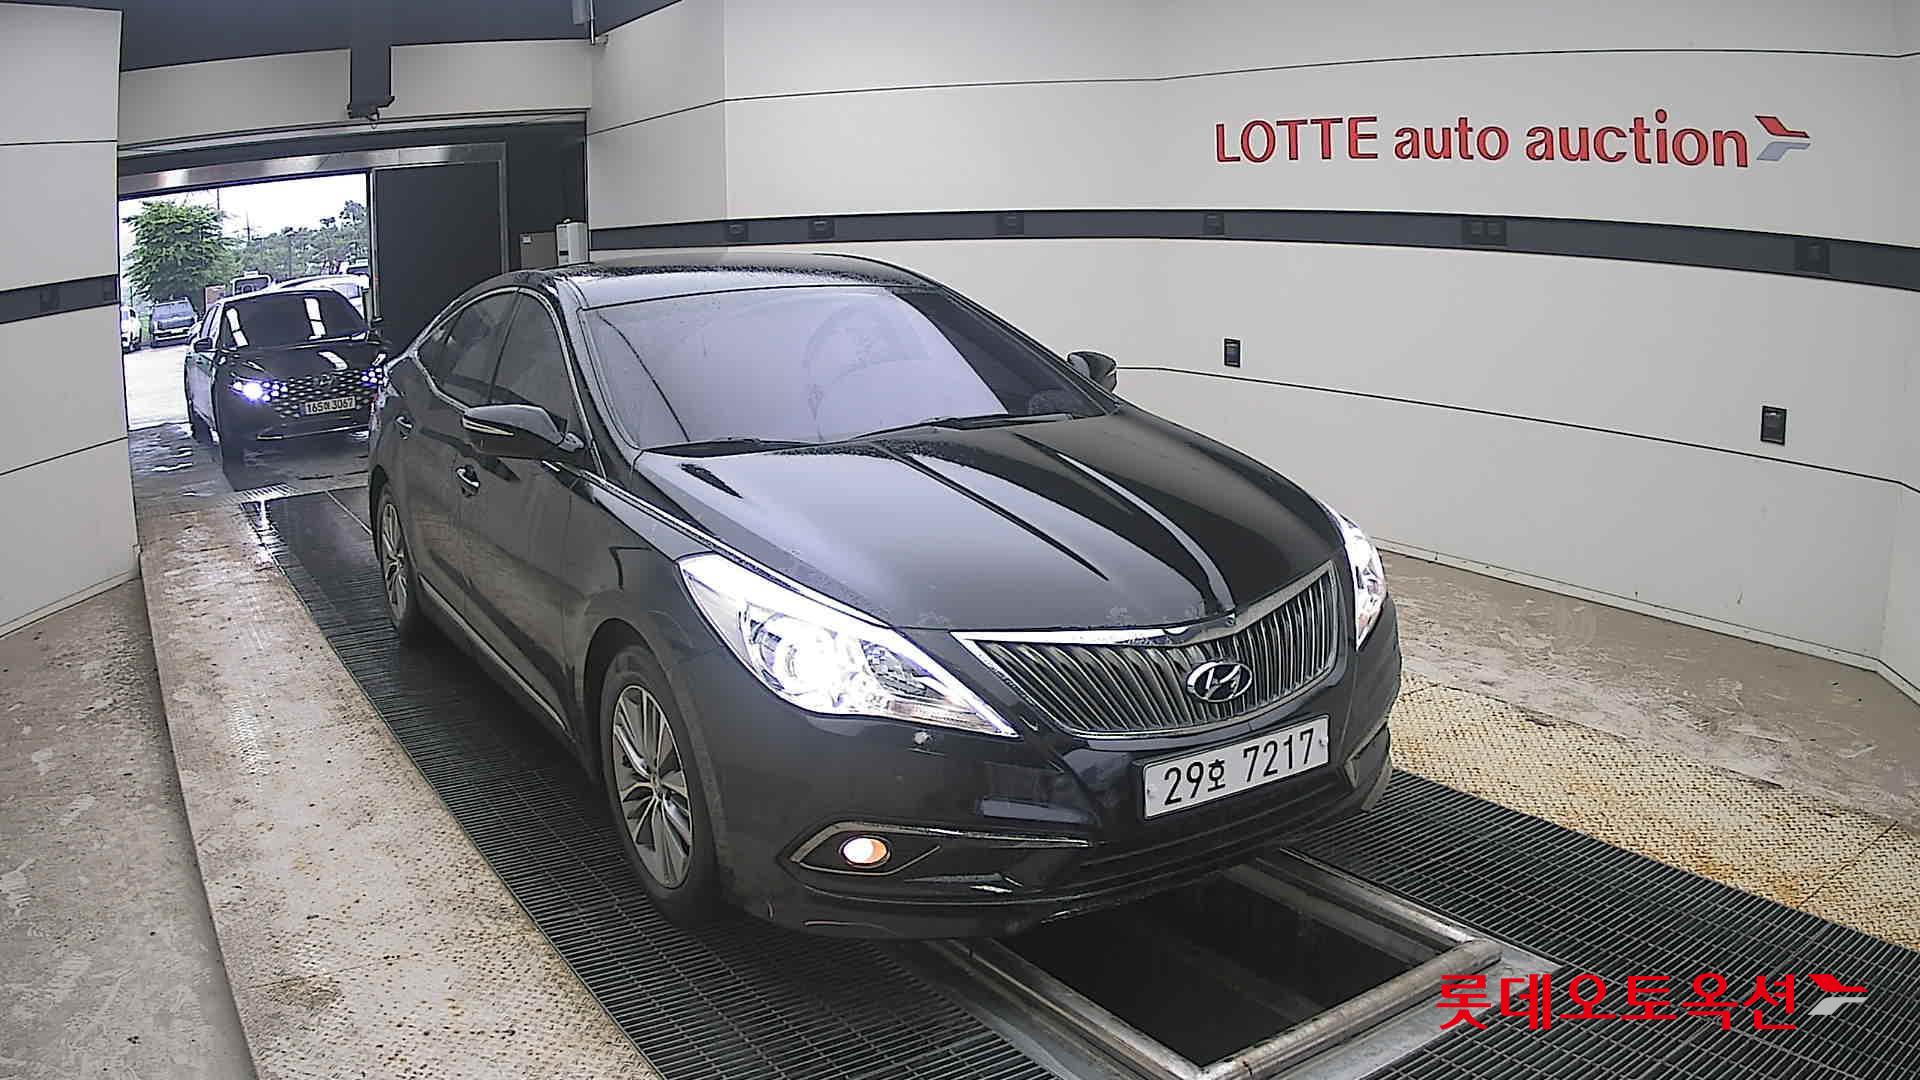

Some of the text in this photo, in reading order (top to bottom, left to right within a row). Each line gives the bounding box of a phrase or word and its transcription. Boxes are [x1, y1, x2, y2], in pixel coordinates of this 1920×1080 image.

[1216, 109, 1749, 167] LOTTE auto auction
[1163, 728, 1314, 806] 29호 7217
